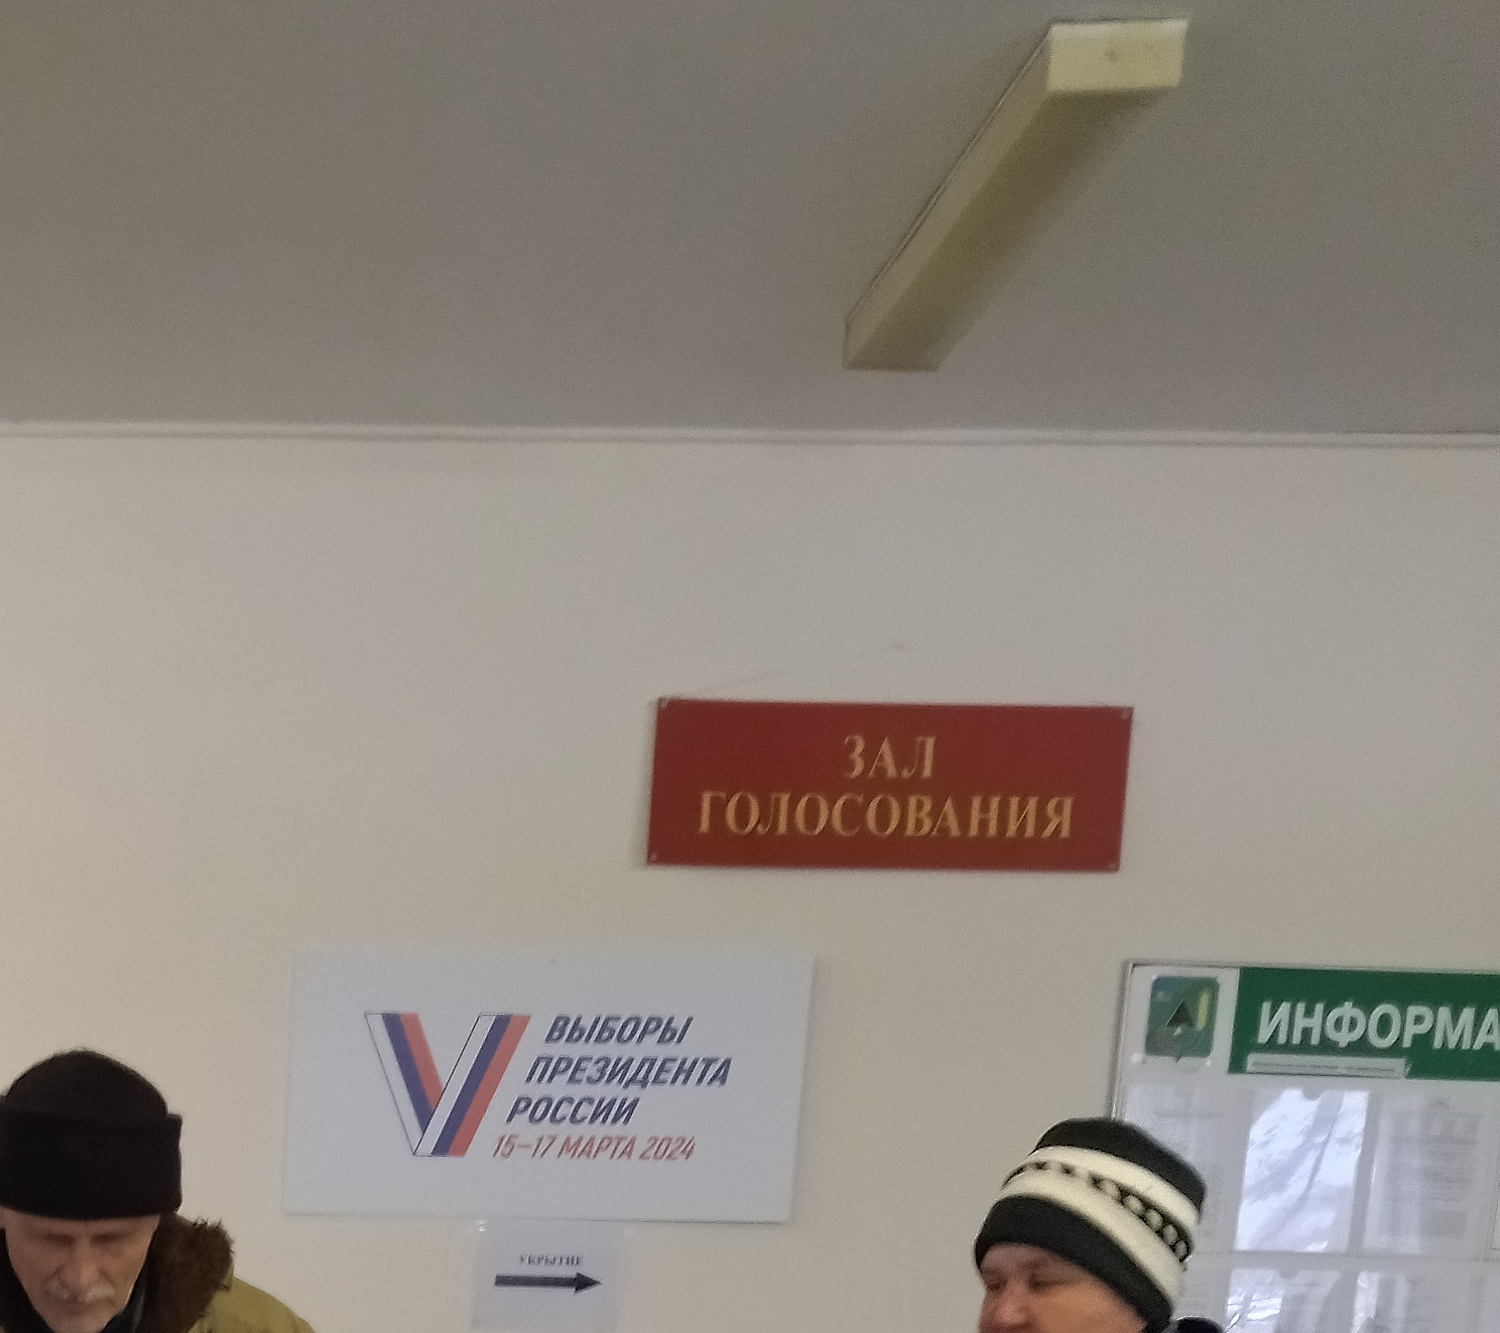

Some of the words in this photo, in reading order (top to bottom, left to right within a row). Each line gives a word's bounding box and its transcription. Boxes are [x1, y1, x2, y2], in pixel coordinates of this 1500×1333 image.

[842, 734, 937, 779] ЗАЛ
[698, 790, 1076, 840] ГОЛОСОВАНИЯ
[544, 1013, 694, 1044] ВЫБОРЫ
[1257, 1000, 1500, 1051] ИНФОРМА
[524, 1054, 733, 1089] ПРЕЗИДЕНТА
[505, 1095, 641, 1125] РОССИИ
[556, 1134, 637, 1160] МАРТА
[638, 1135, 696, 1161] 2024
